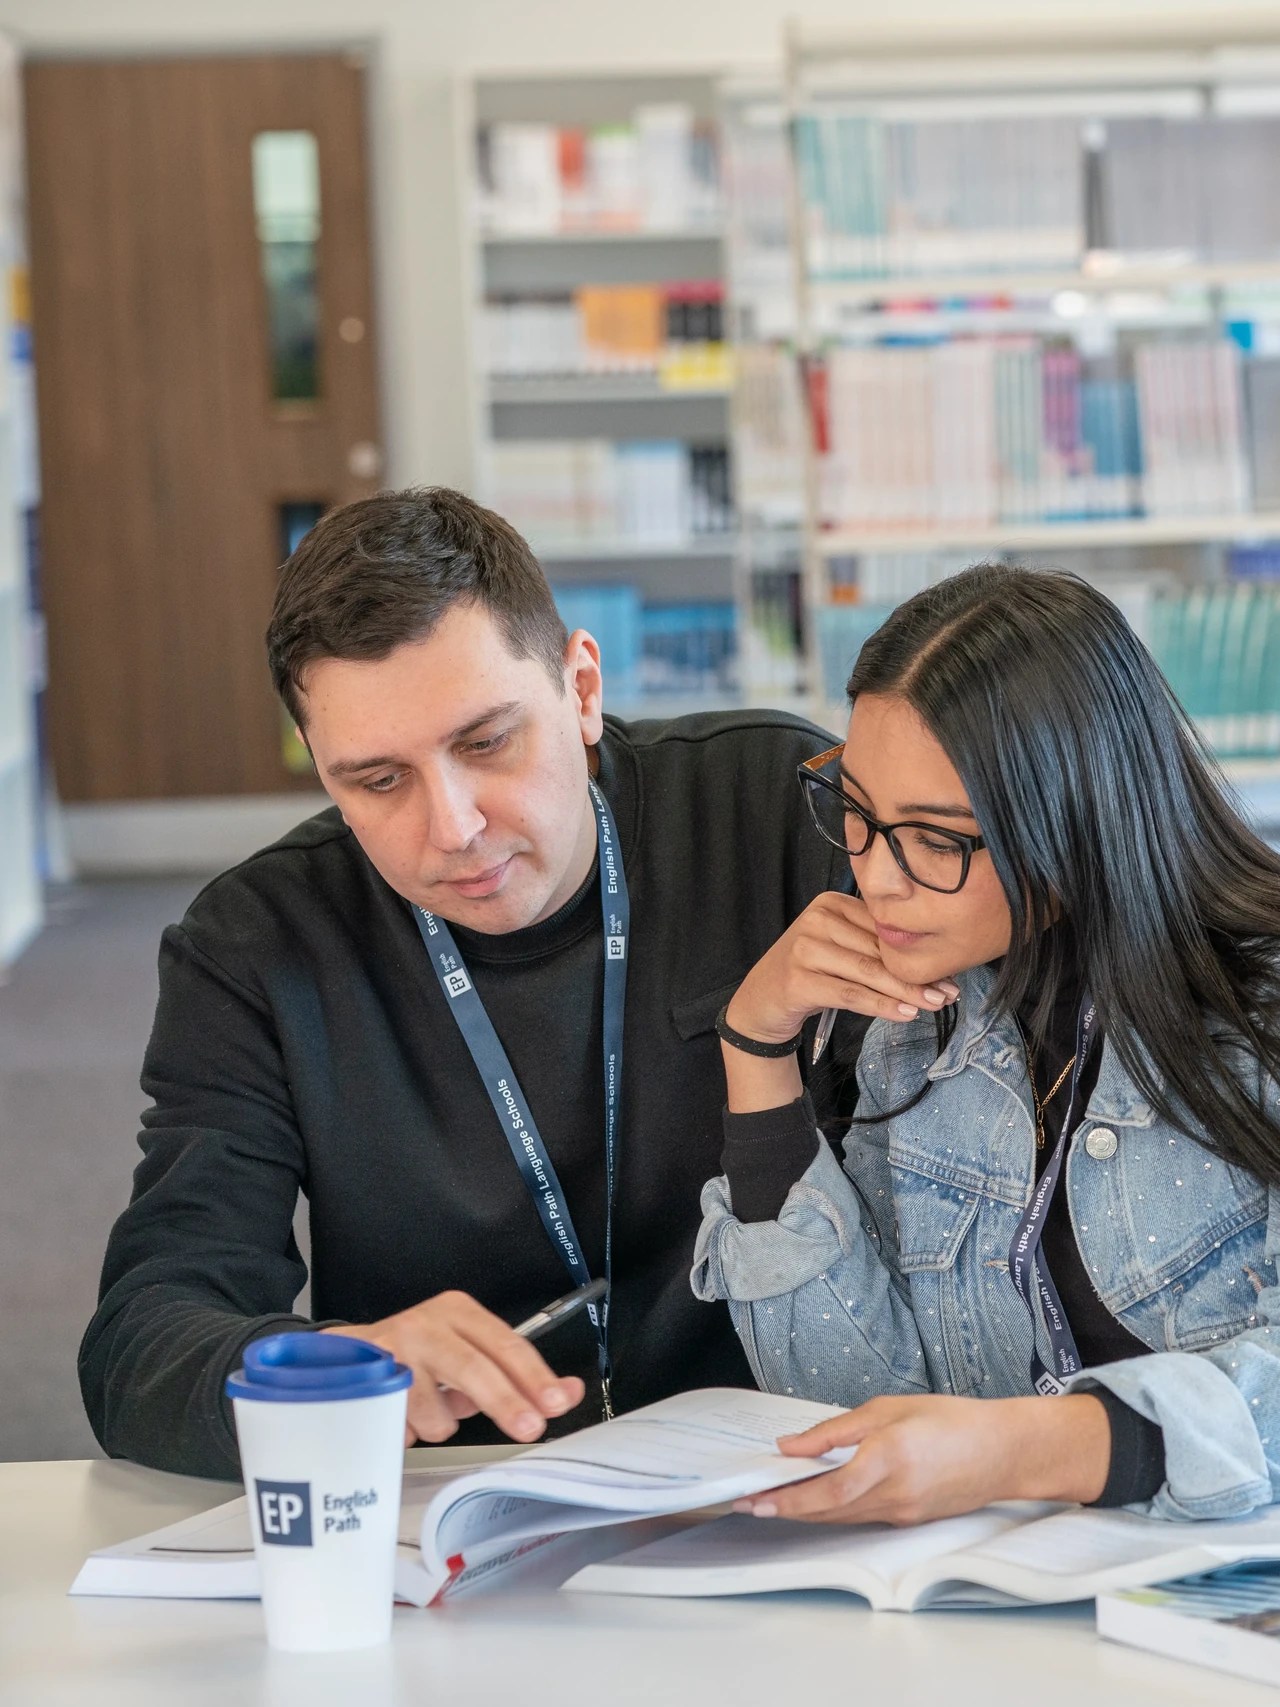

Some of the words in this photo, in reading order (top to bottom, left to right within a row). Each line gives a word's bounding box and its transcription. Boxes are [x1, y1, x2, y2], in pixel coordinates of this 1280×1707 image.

[600, 815, 612, 843] Path
[605, 847, 618, 894] English
[610, 939, 622, 956] EP
[449, 976, 466, 992] EP
[497, 1078, 524, 1130] Schools
[519, 1130, 550, 1190] Language
[544, 1190, 561, 1220] Path
[1029, 1176, 1052, 1221] English
[554, 1221, 579, 1265] English
[1017, 1223, 1035, 1253] Path
[1040, 1286, 1063, 1331] English
[1039, 1378, 1060, 1397] EP
[260, 1490, 303, 1535] EP
[323, 1488, 378, 1514] English
[324, 1515, 361, 1533] Path
